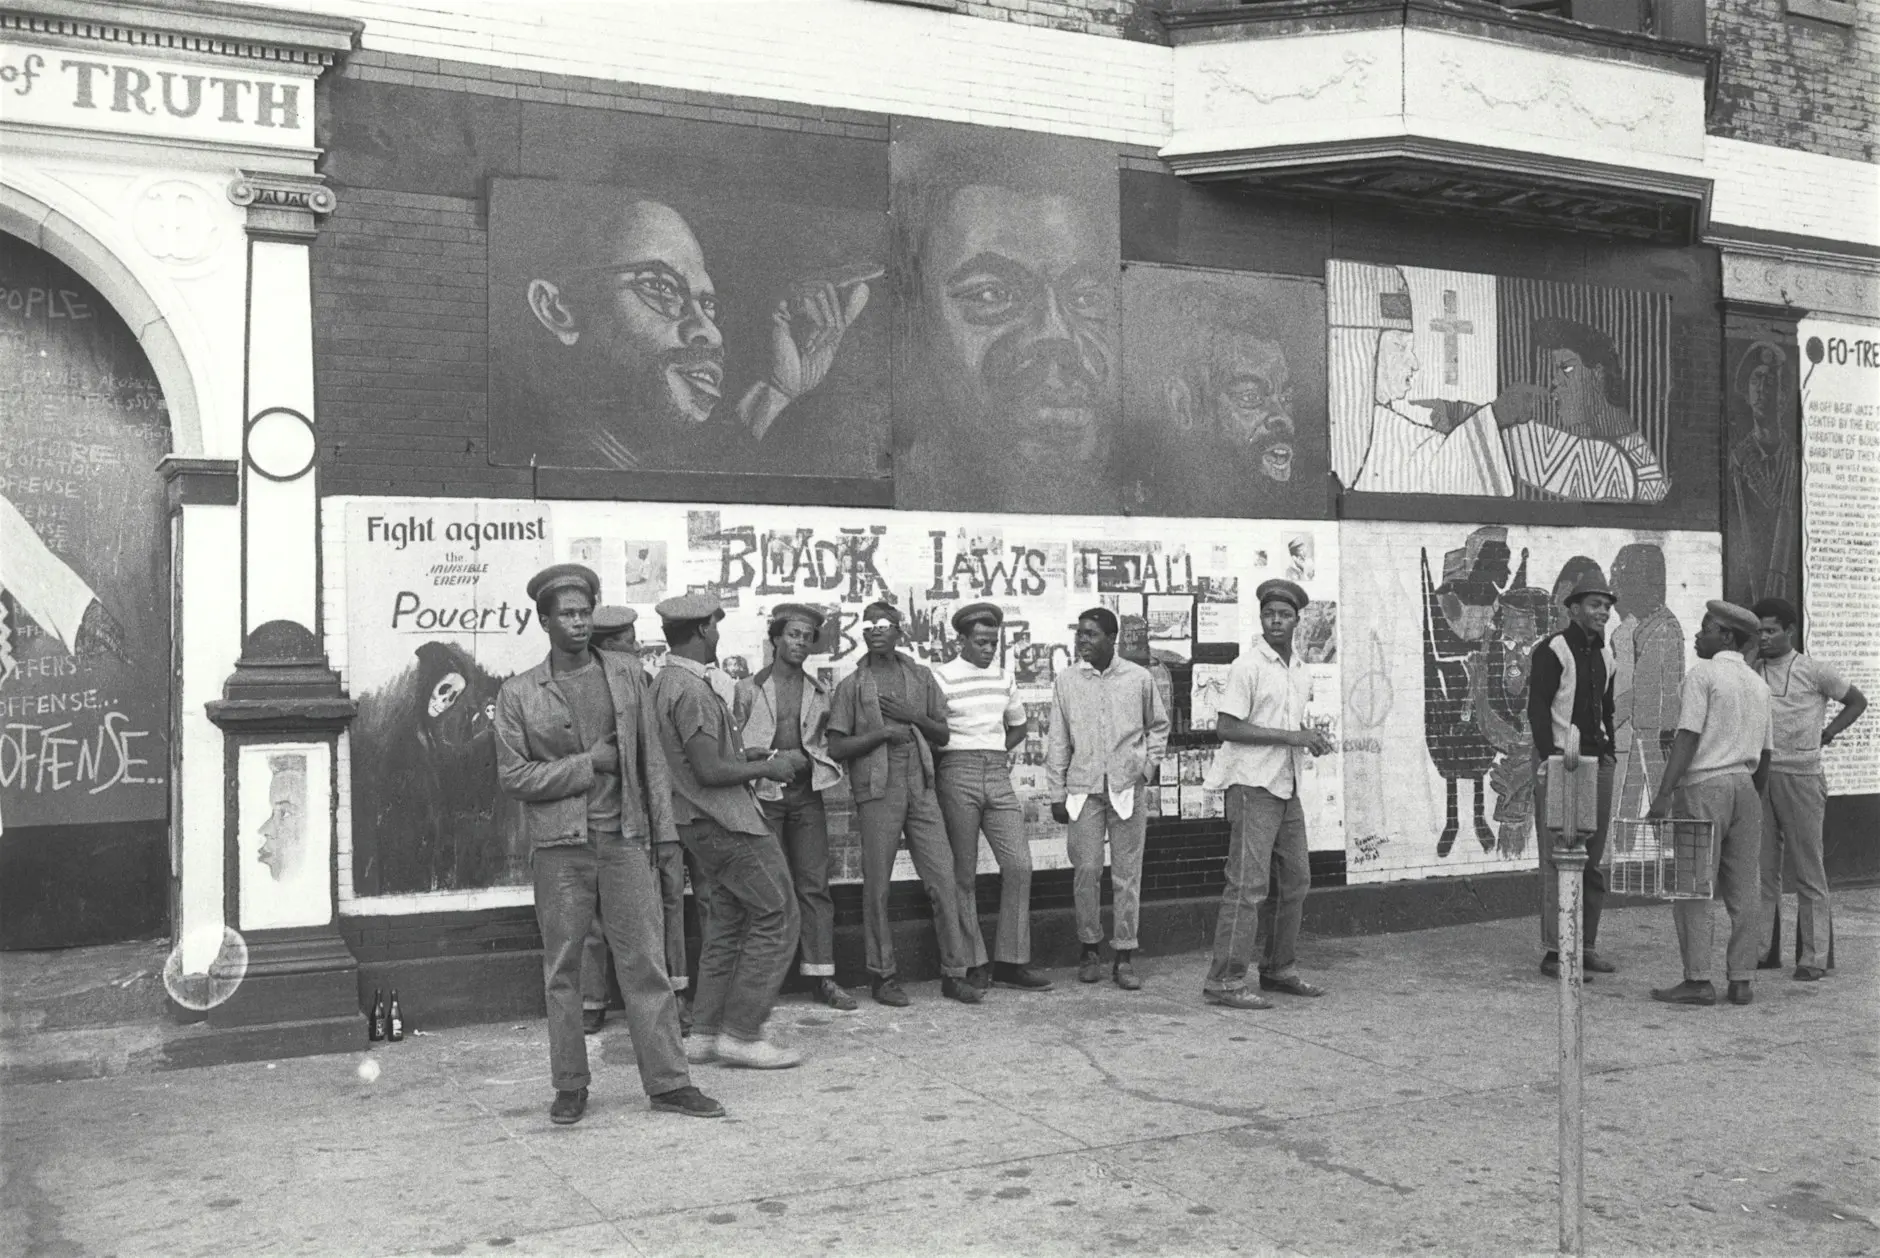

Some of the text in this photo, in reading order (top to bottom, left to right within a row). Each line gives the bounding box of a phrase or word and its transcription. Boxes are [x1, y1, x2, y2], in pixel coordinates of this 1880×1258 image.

[0, 54, 301, 129] of TRUTH
[367, 516, 547, 551] Fight against
[445, 552, 464, 563] the
[926, 530, 1046, 600] LAWS
[391, 591, 532, 636] Poverty
